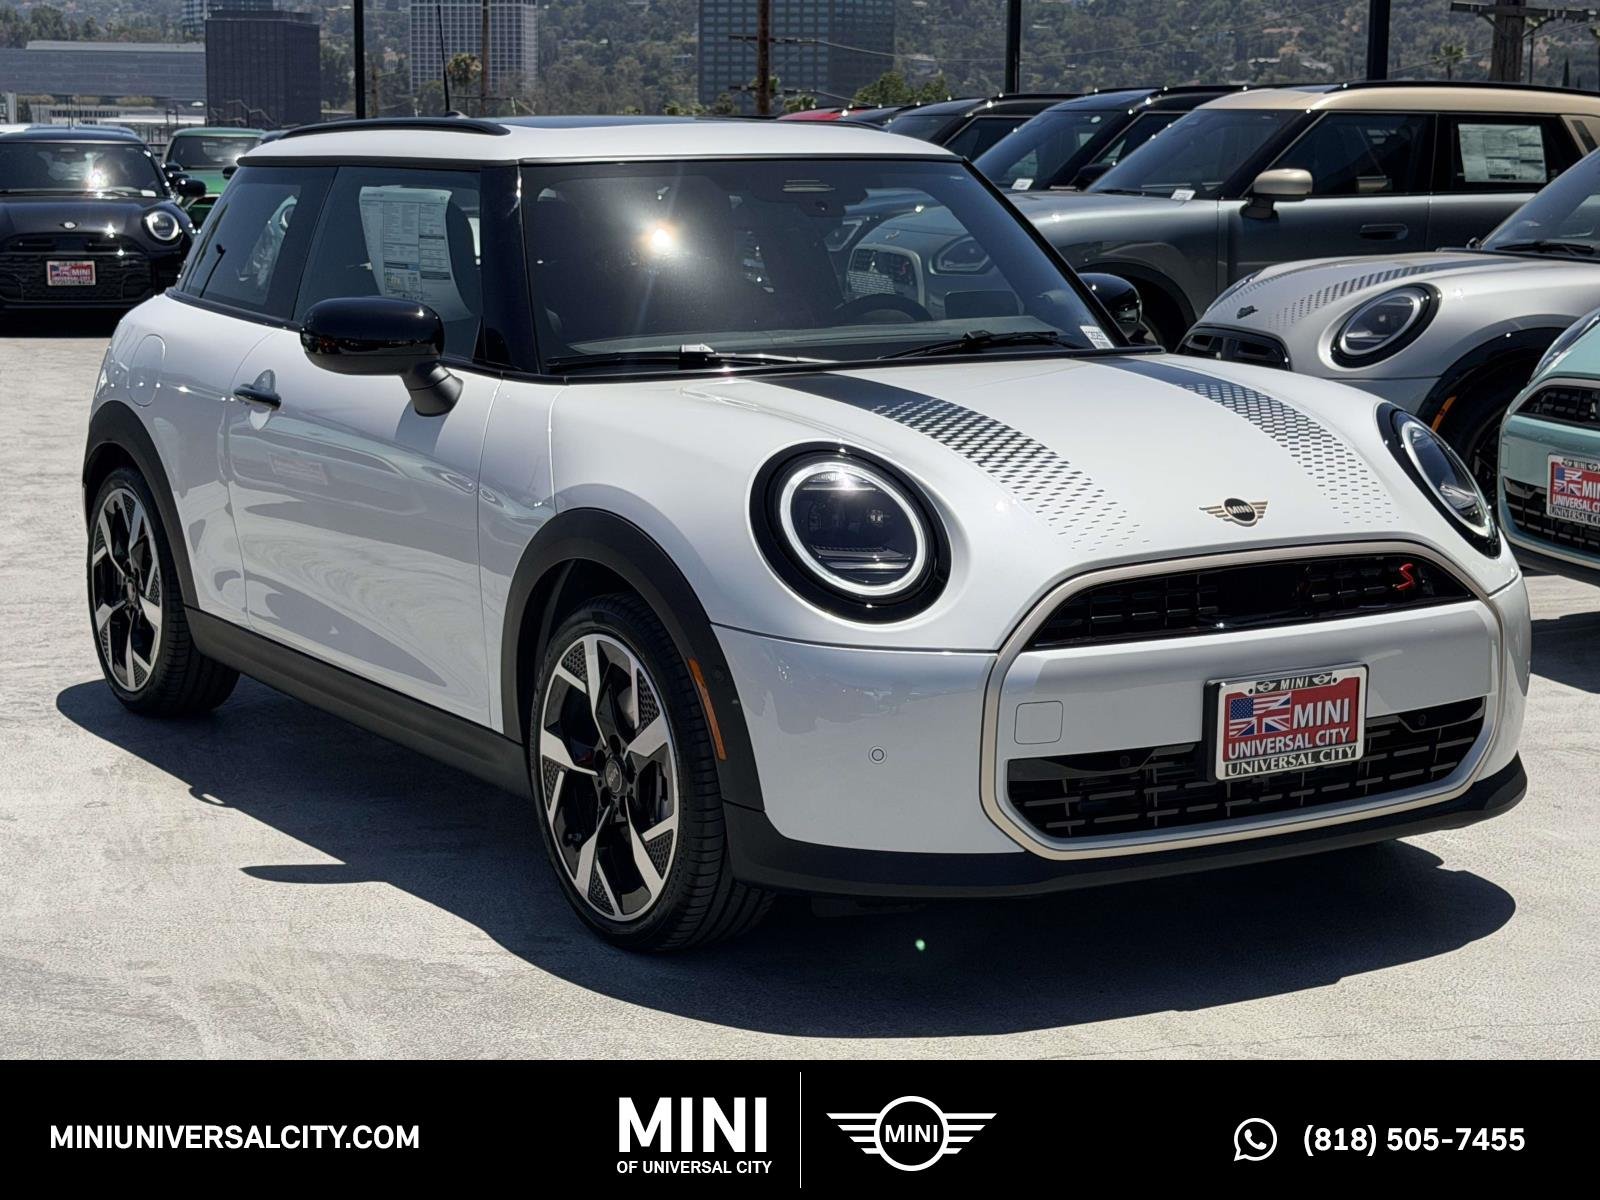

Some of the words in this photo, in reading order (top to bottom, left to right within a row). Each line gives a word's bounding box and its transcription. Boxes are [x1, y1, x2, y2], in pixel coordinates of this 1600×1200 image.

[1227, 505, 1253, 514] MINI
[1552, 494, 1592, 511] UNIVERSAL
[1396, 563, 1414, 590] S
[1280, 676, 1309, 691] MINI
[1292, 698, 1349, 729] MINI
[1228, 733, 1313, 759] UNIVERSAL
[1315, 727, 1350, 746] CITY
[1227, 753, 1316, 776] UNIVERSAL
[1319, 745, 1356, 762] CITY
